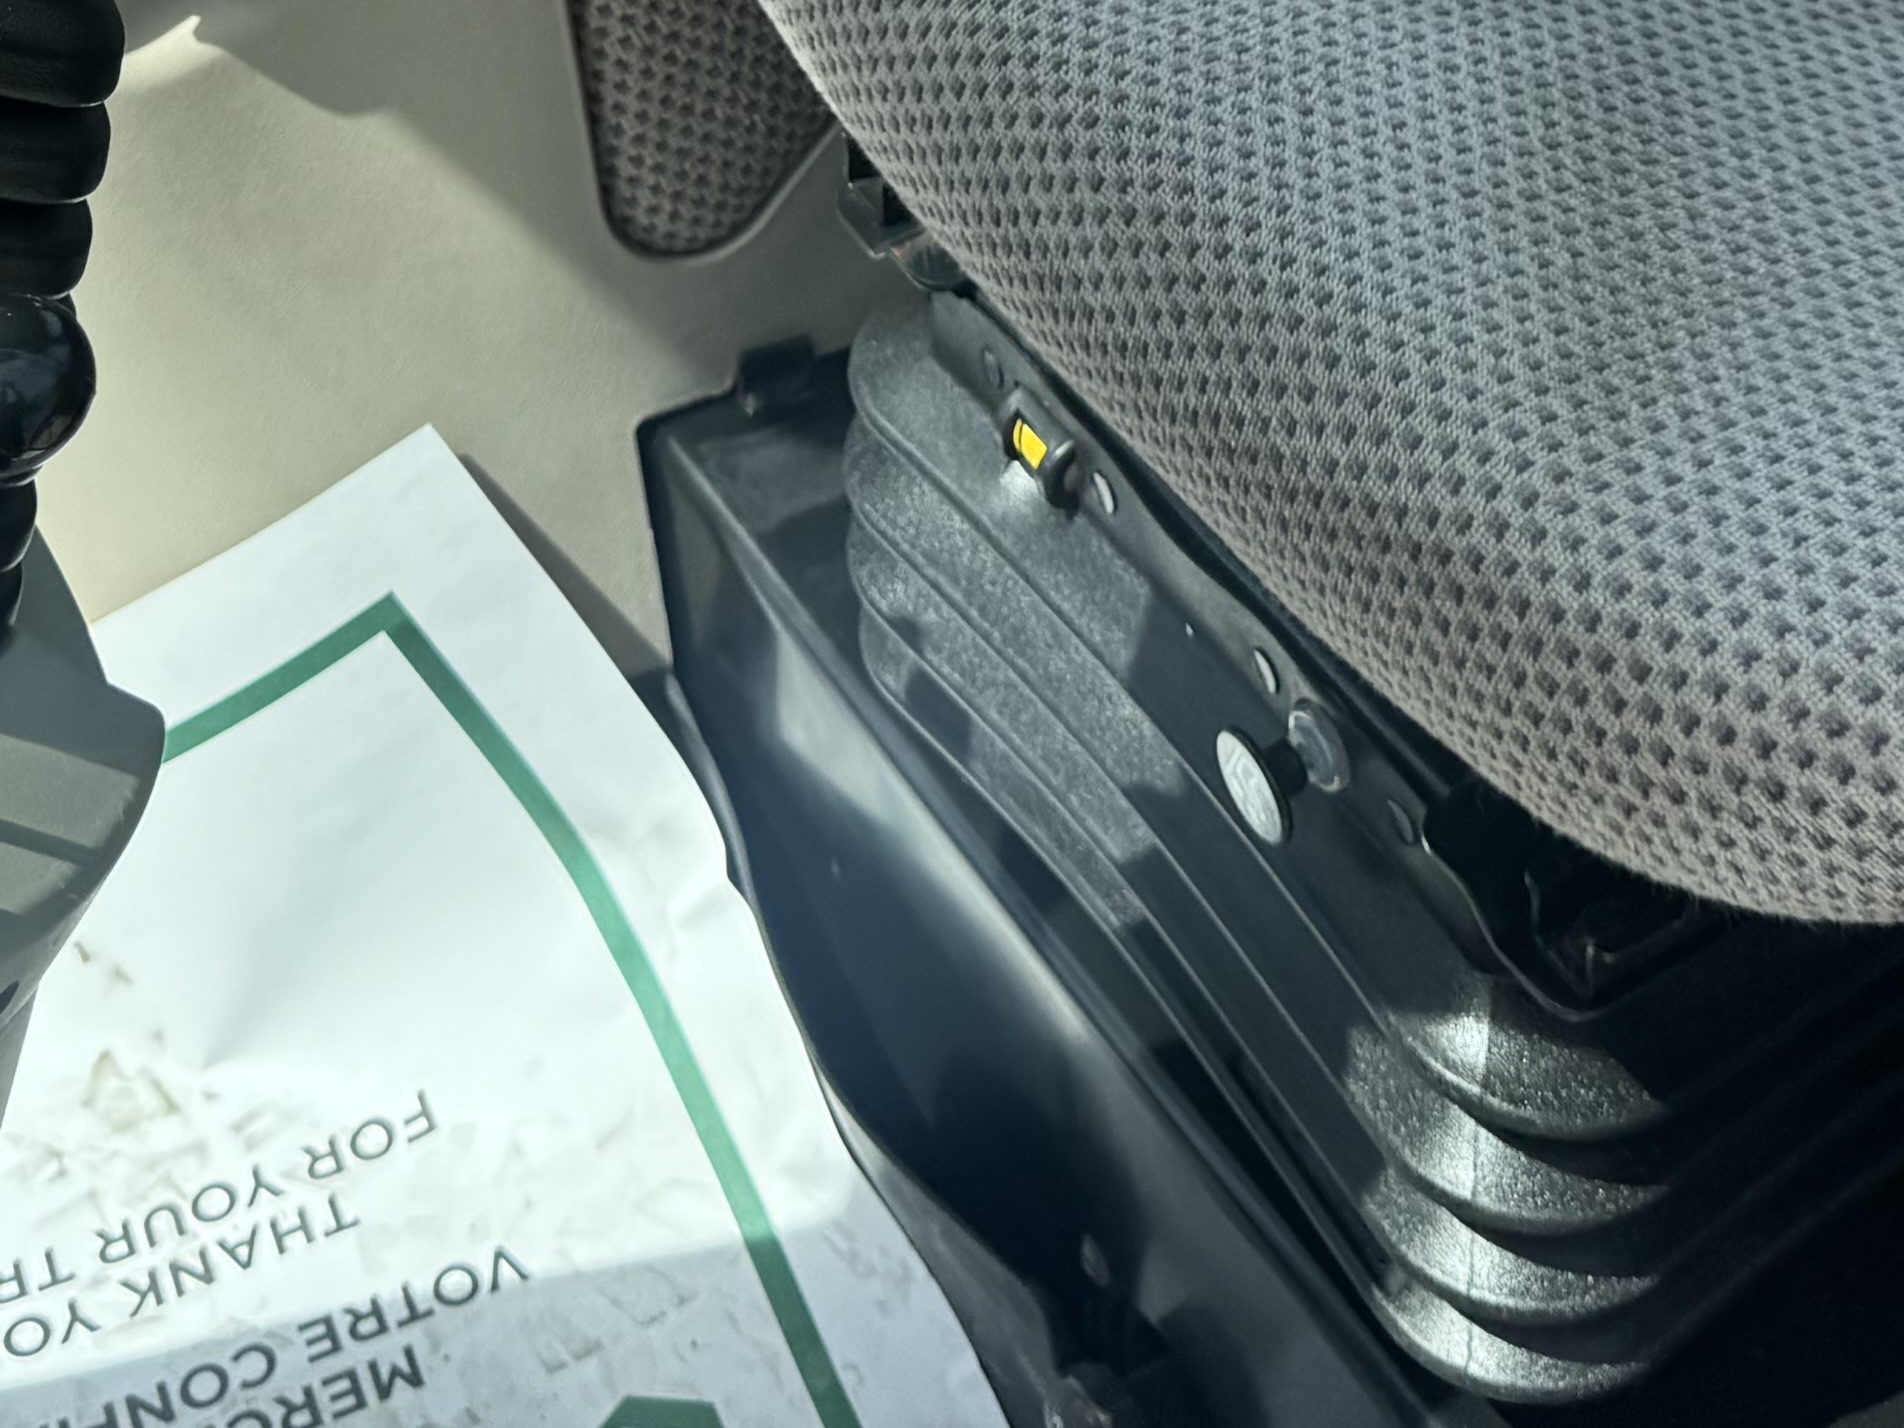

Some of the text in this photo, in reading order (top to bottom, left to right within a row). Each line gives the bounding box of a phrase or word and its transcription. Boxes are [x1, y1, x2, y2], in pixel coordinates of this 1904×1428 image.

[301, 1088, 438, 1180] FOR
[95, 1163, 285, 1264] YOUR
[119, 1192, 361, 1318] THANK
[297, 1244, 529, 1364] VOTRE
[208, 1343, 426, 1428] MER
